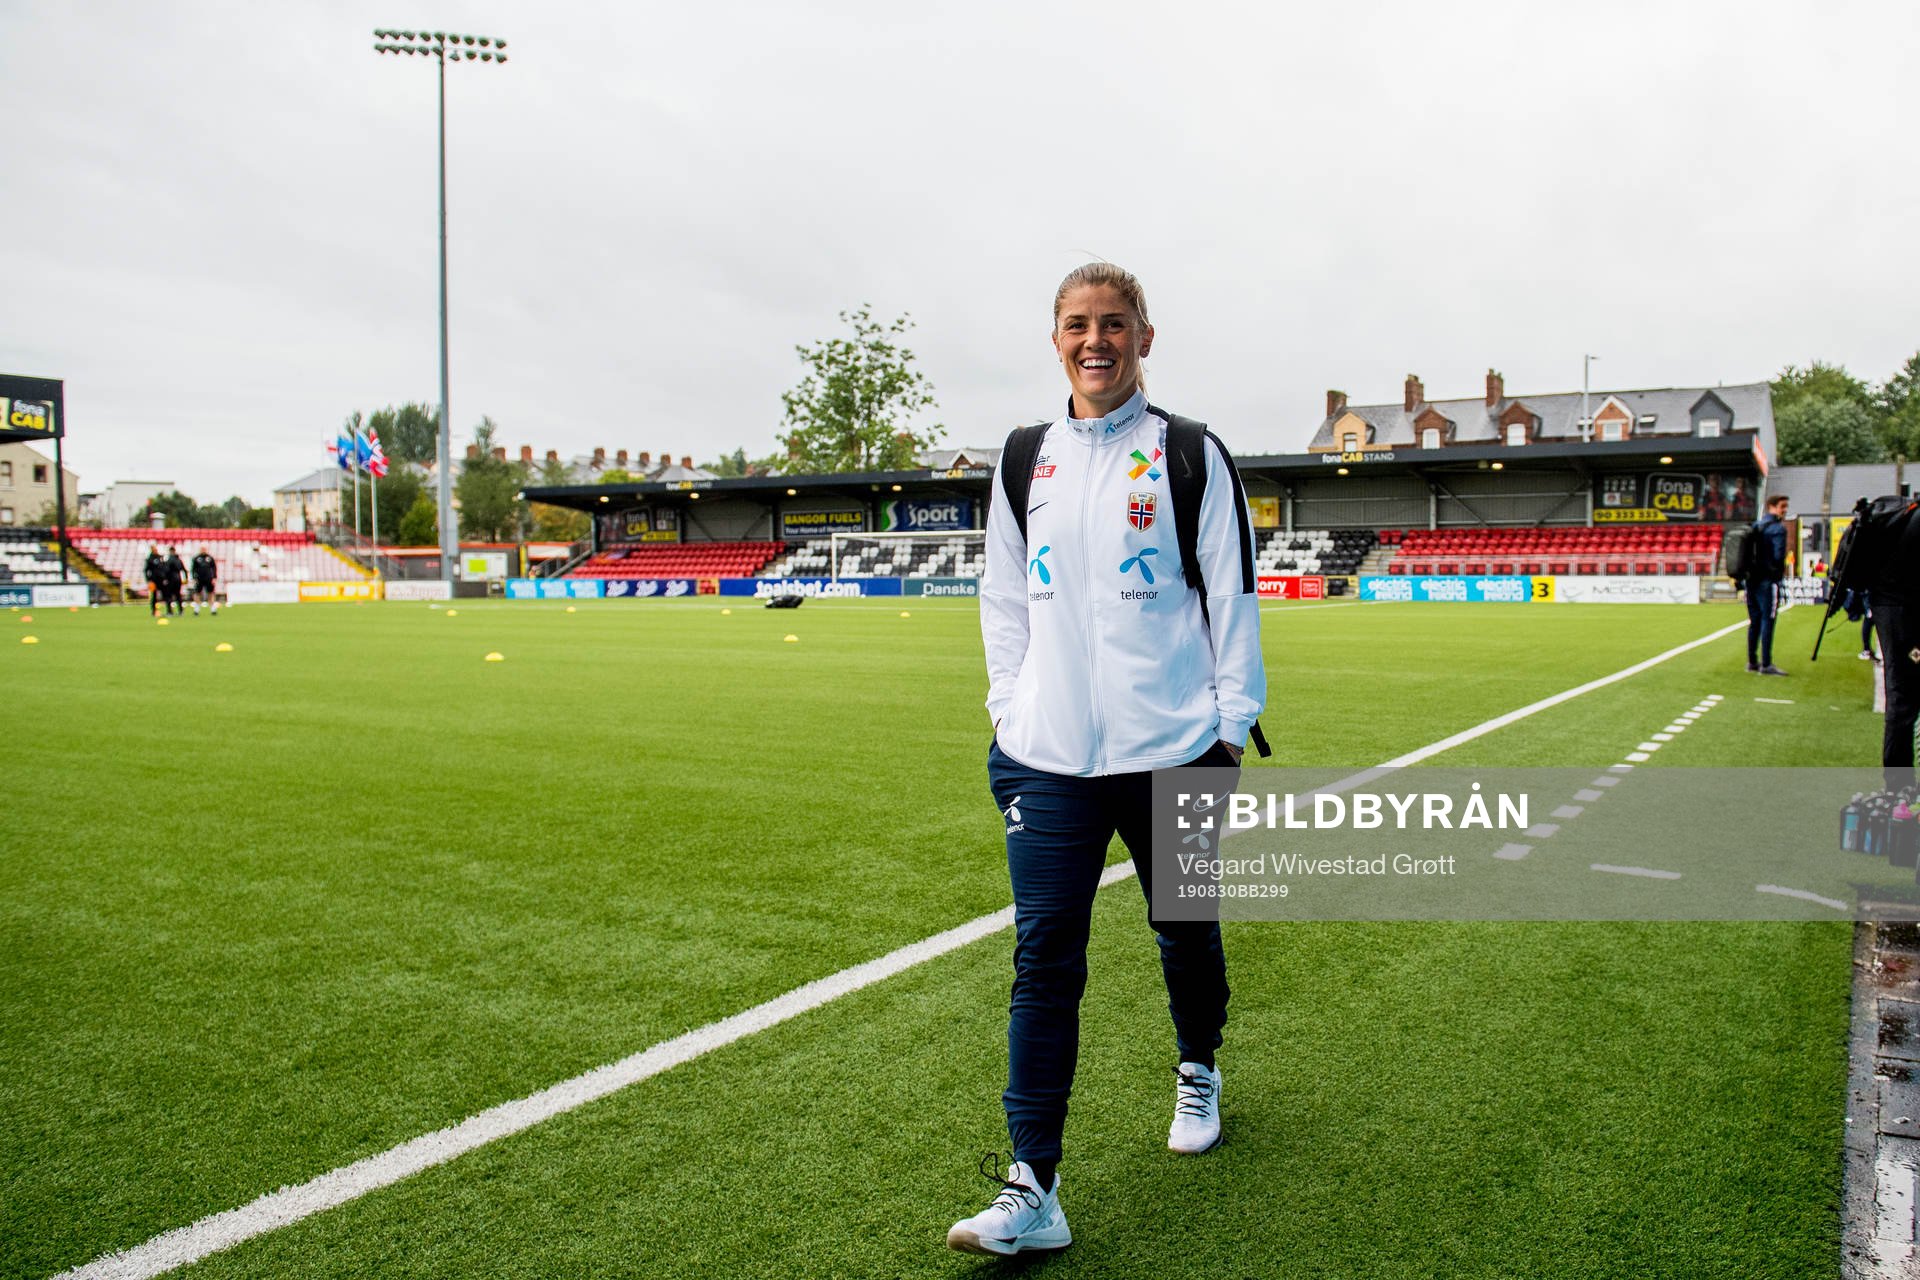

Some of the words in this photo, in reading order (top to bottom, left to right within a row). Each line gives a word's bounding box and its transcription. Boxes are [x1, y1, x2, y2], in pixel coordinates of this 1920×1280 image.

[11, 411, 45, 430] CAB
[1113, 413, 1135, 430] telenor
[1656, 478, 1693, 494] fona
[1654, 493, 1695, 510] CAB
[784, 514, 826, 525] BANGOR
[829, 512, 862, 523] FUELS
[627, 520, 648, 535] CAB
[923, 583, 976, 595] Danske
[1121, 589, 1158, 600] telenor
